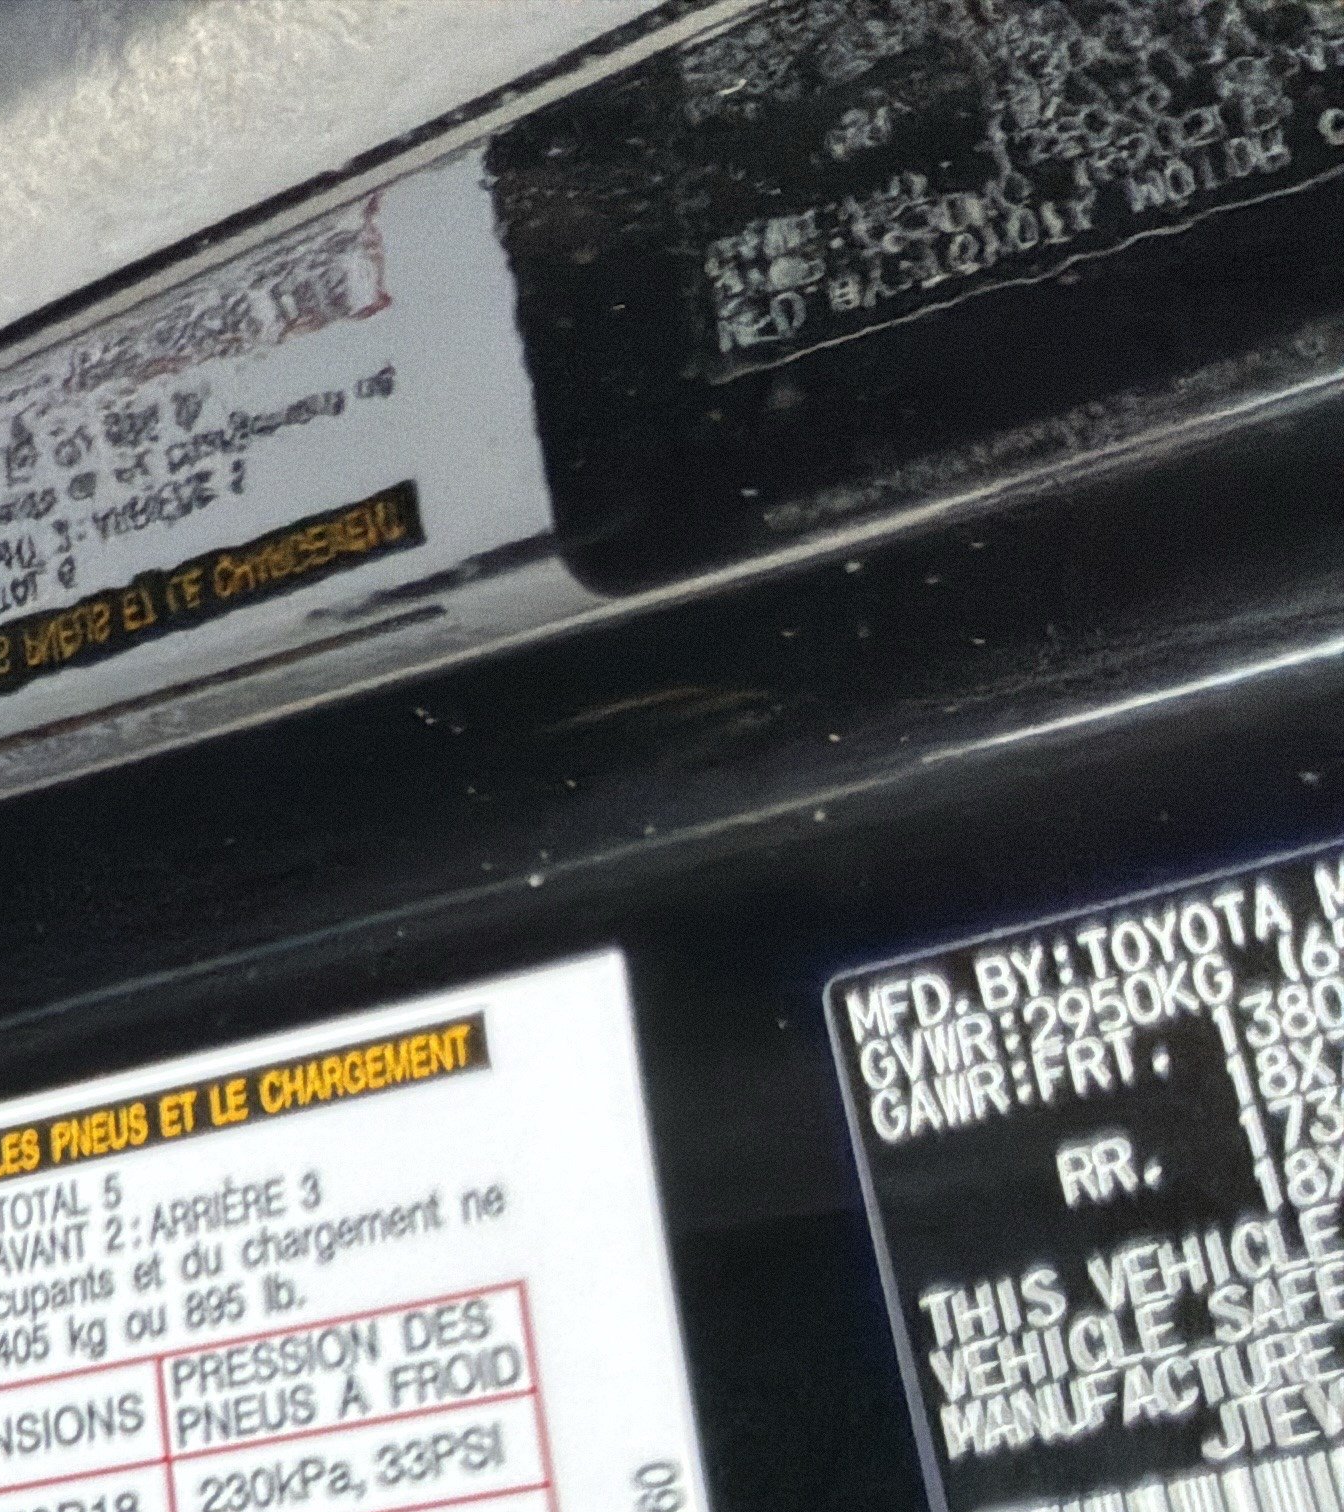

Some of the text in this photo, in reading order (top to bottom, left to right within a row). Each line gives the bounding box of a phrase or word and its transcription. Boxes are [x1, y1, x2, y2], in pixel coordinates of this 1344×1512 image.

[844, 972, 970, 1045] MFD.
[48, 1101, 150, 1163] PNEUS
[158, 1088, 198, 1138] ET
[208, 1077, 249, 1126] LE
[258, 1022, 470, 1114] CHARGEMENT
[1055, 1136, 1164, 1209] RR.
[131, 1251, 163, 1293] et
[179, 1240, 224, 1283] du
[240, 1190, 443, 1270] chargement
[459, 1183, 506, 1223] ne
[919, 1202, 1344, 1348] THIS VEHICLE
[66, 1314, 108, 1362] kg
[123, 1304, 168, 1343] ou
[183, 1281, 246, 1331] 895
[261, 1272, 306, 1315] lb.
[170, 1294, 492, 1400] PRESSION DES
[927, 1300, 1187, 1403] VEHICLE
